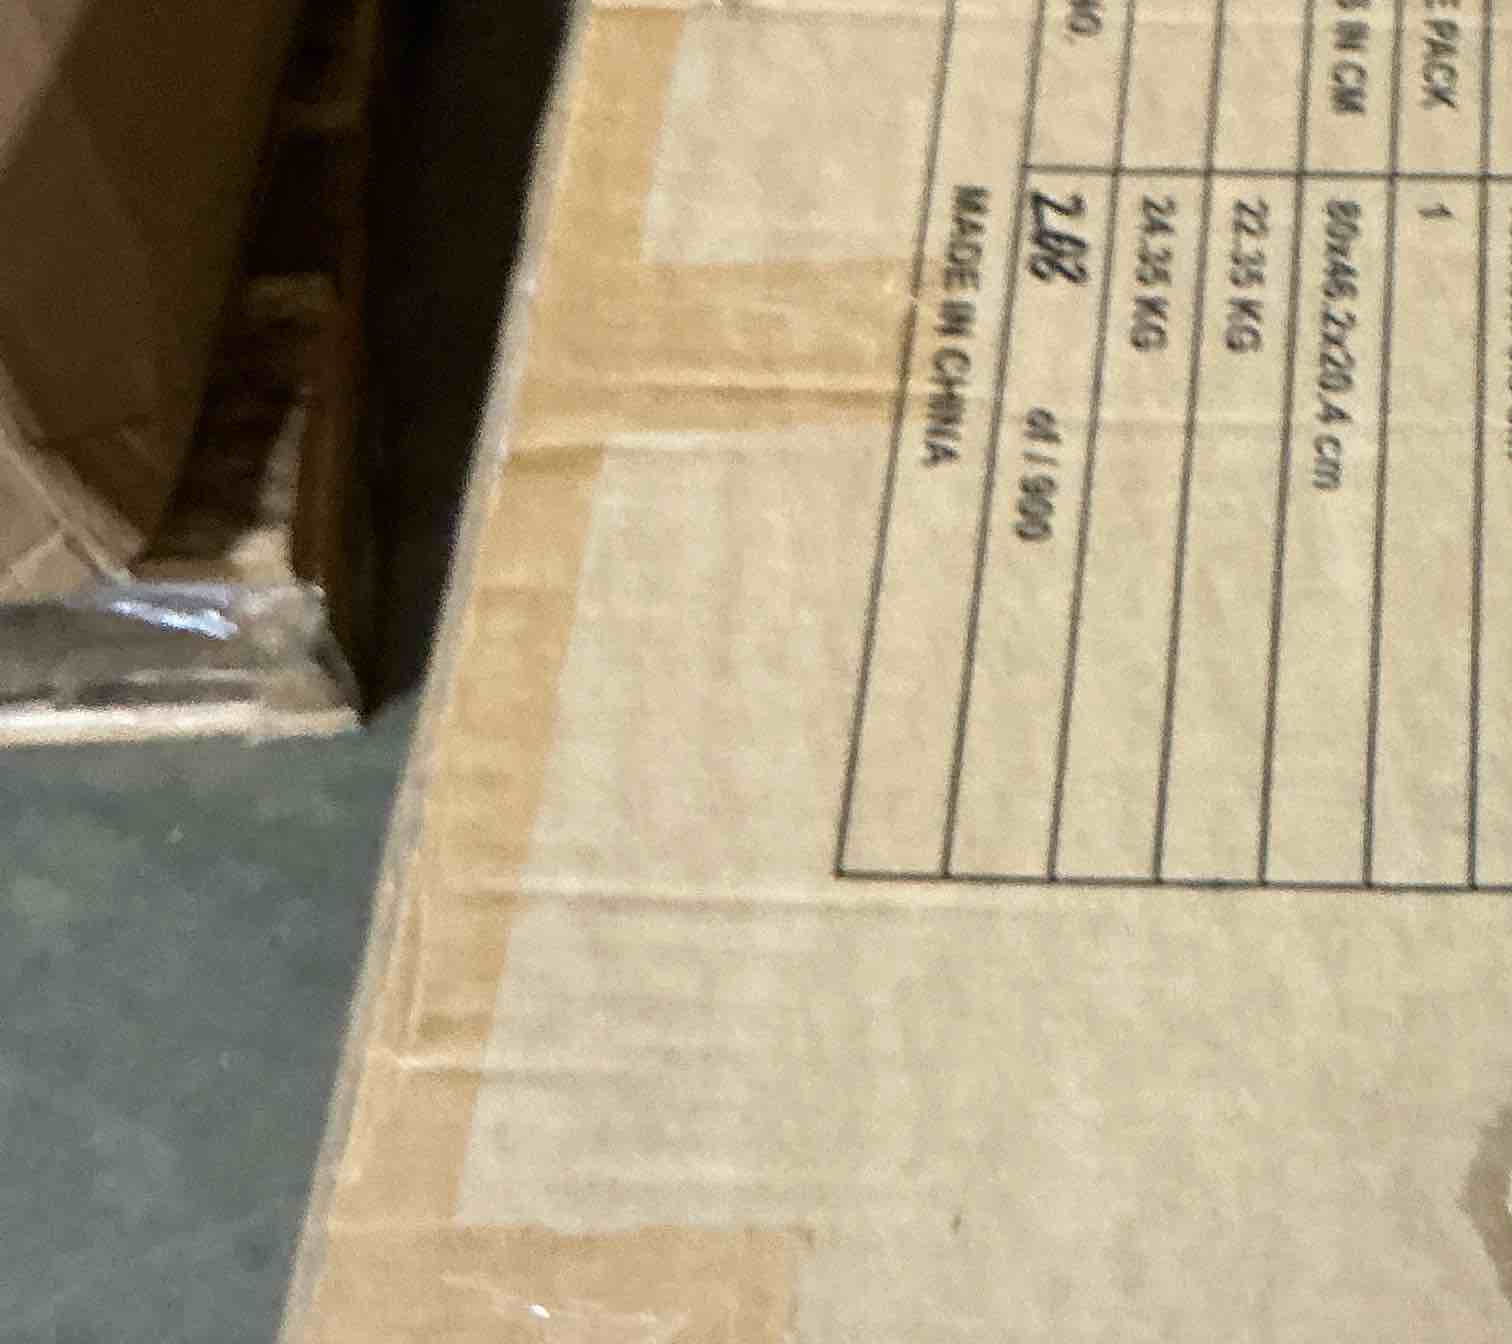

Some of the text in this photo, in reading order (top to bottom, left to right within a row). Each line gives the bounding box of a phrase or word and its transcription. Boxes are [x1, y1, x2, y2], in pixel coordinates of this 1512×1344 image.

[1335, 21, 1367, 51] IN
[1330, 59, 1366, 115] CM
[1420, 19, 1455, 110] PACK
[1419, 203, 1452, 221] 1
[1130, 195, 1175, 352] 24.35 KG
[1225, 197, 1267, 354] 22.35 KG
[922, 186, 989, 469] MADE IN CHINA
[1024, 408, 1057, 447] of
[1311, 434, 1340, 490] cm
